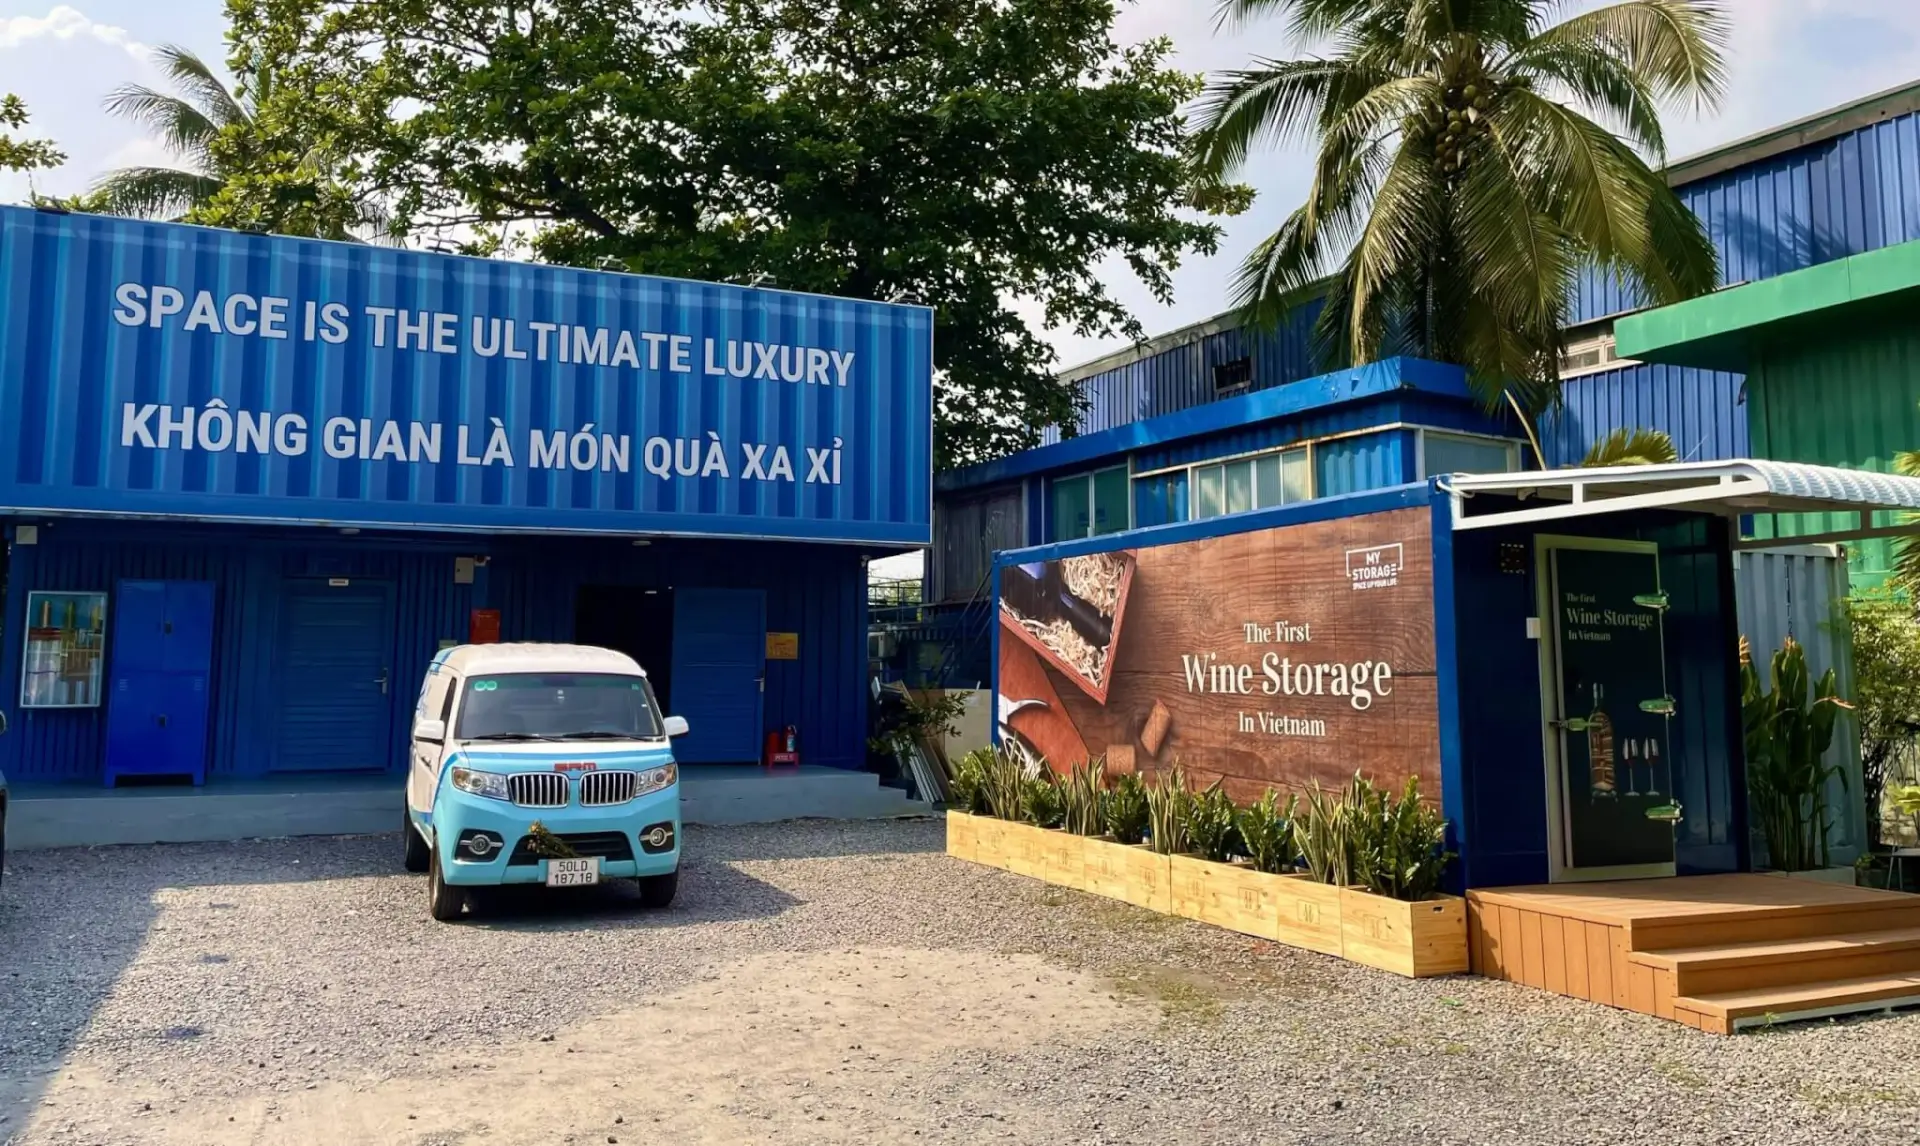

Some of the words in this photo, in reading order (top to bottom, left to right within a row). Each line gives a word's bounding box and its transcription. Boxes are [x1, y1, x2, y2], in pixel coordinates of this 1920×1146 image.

[113, 282, 290, 340] SPACE
[303, 300, 350, 345] IS
[364, 305, 459, 355] THE
[471, 315, 693, 374] ULTIMATE
[704, 337, 856, 388] LUXURY
[120, 397, 308, 457] KHÔNG
[322, 416, 442, 465] GIAN
[456, 416, 515, 468] LÀ
[528, 422, 630, 474] MÓN
[644, 430, 730, 481] QUÀ
[740, 443, 796, 483] XA
[804, 436, 844, 485] XỈ
[1366, 551, 1380, 565] MY
[1352, 563, 1397, 581] STORAGE
[1566, 592, 1579, 602] The
[1566, 607, 1600, 625] Wine
[1603, 608, 1653, 630] Storage
[1243, 621, 1273, 645] The
[1275, 620, 1311, 643] First
[1568, 629, 1577, 640] In
[1578, 630, 1611, 641] Vietnam
[1182, 652, 1253, 695] Wine
[1261, 652, 1393, 711] Storage
[1238, 711, 1255, 734] In
[1258, 711, 1326, 738] Vietnam
[558, 861, 588, 873] 50LD
[554, 872, 593, 885] 187.18
